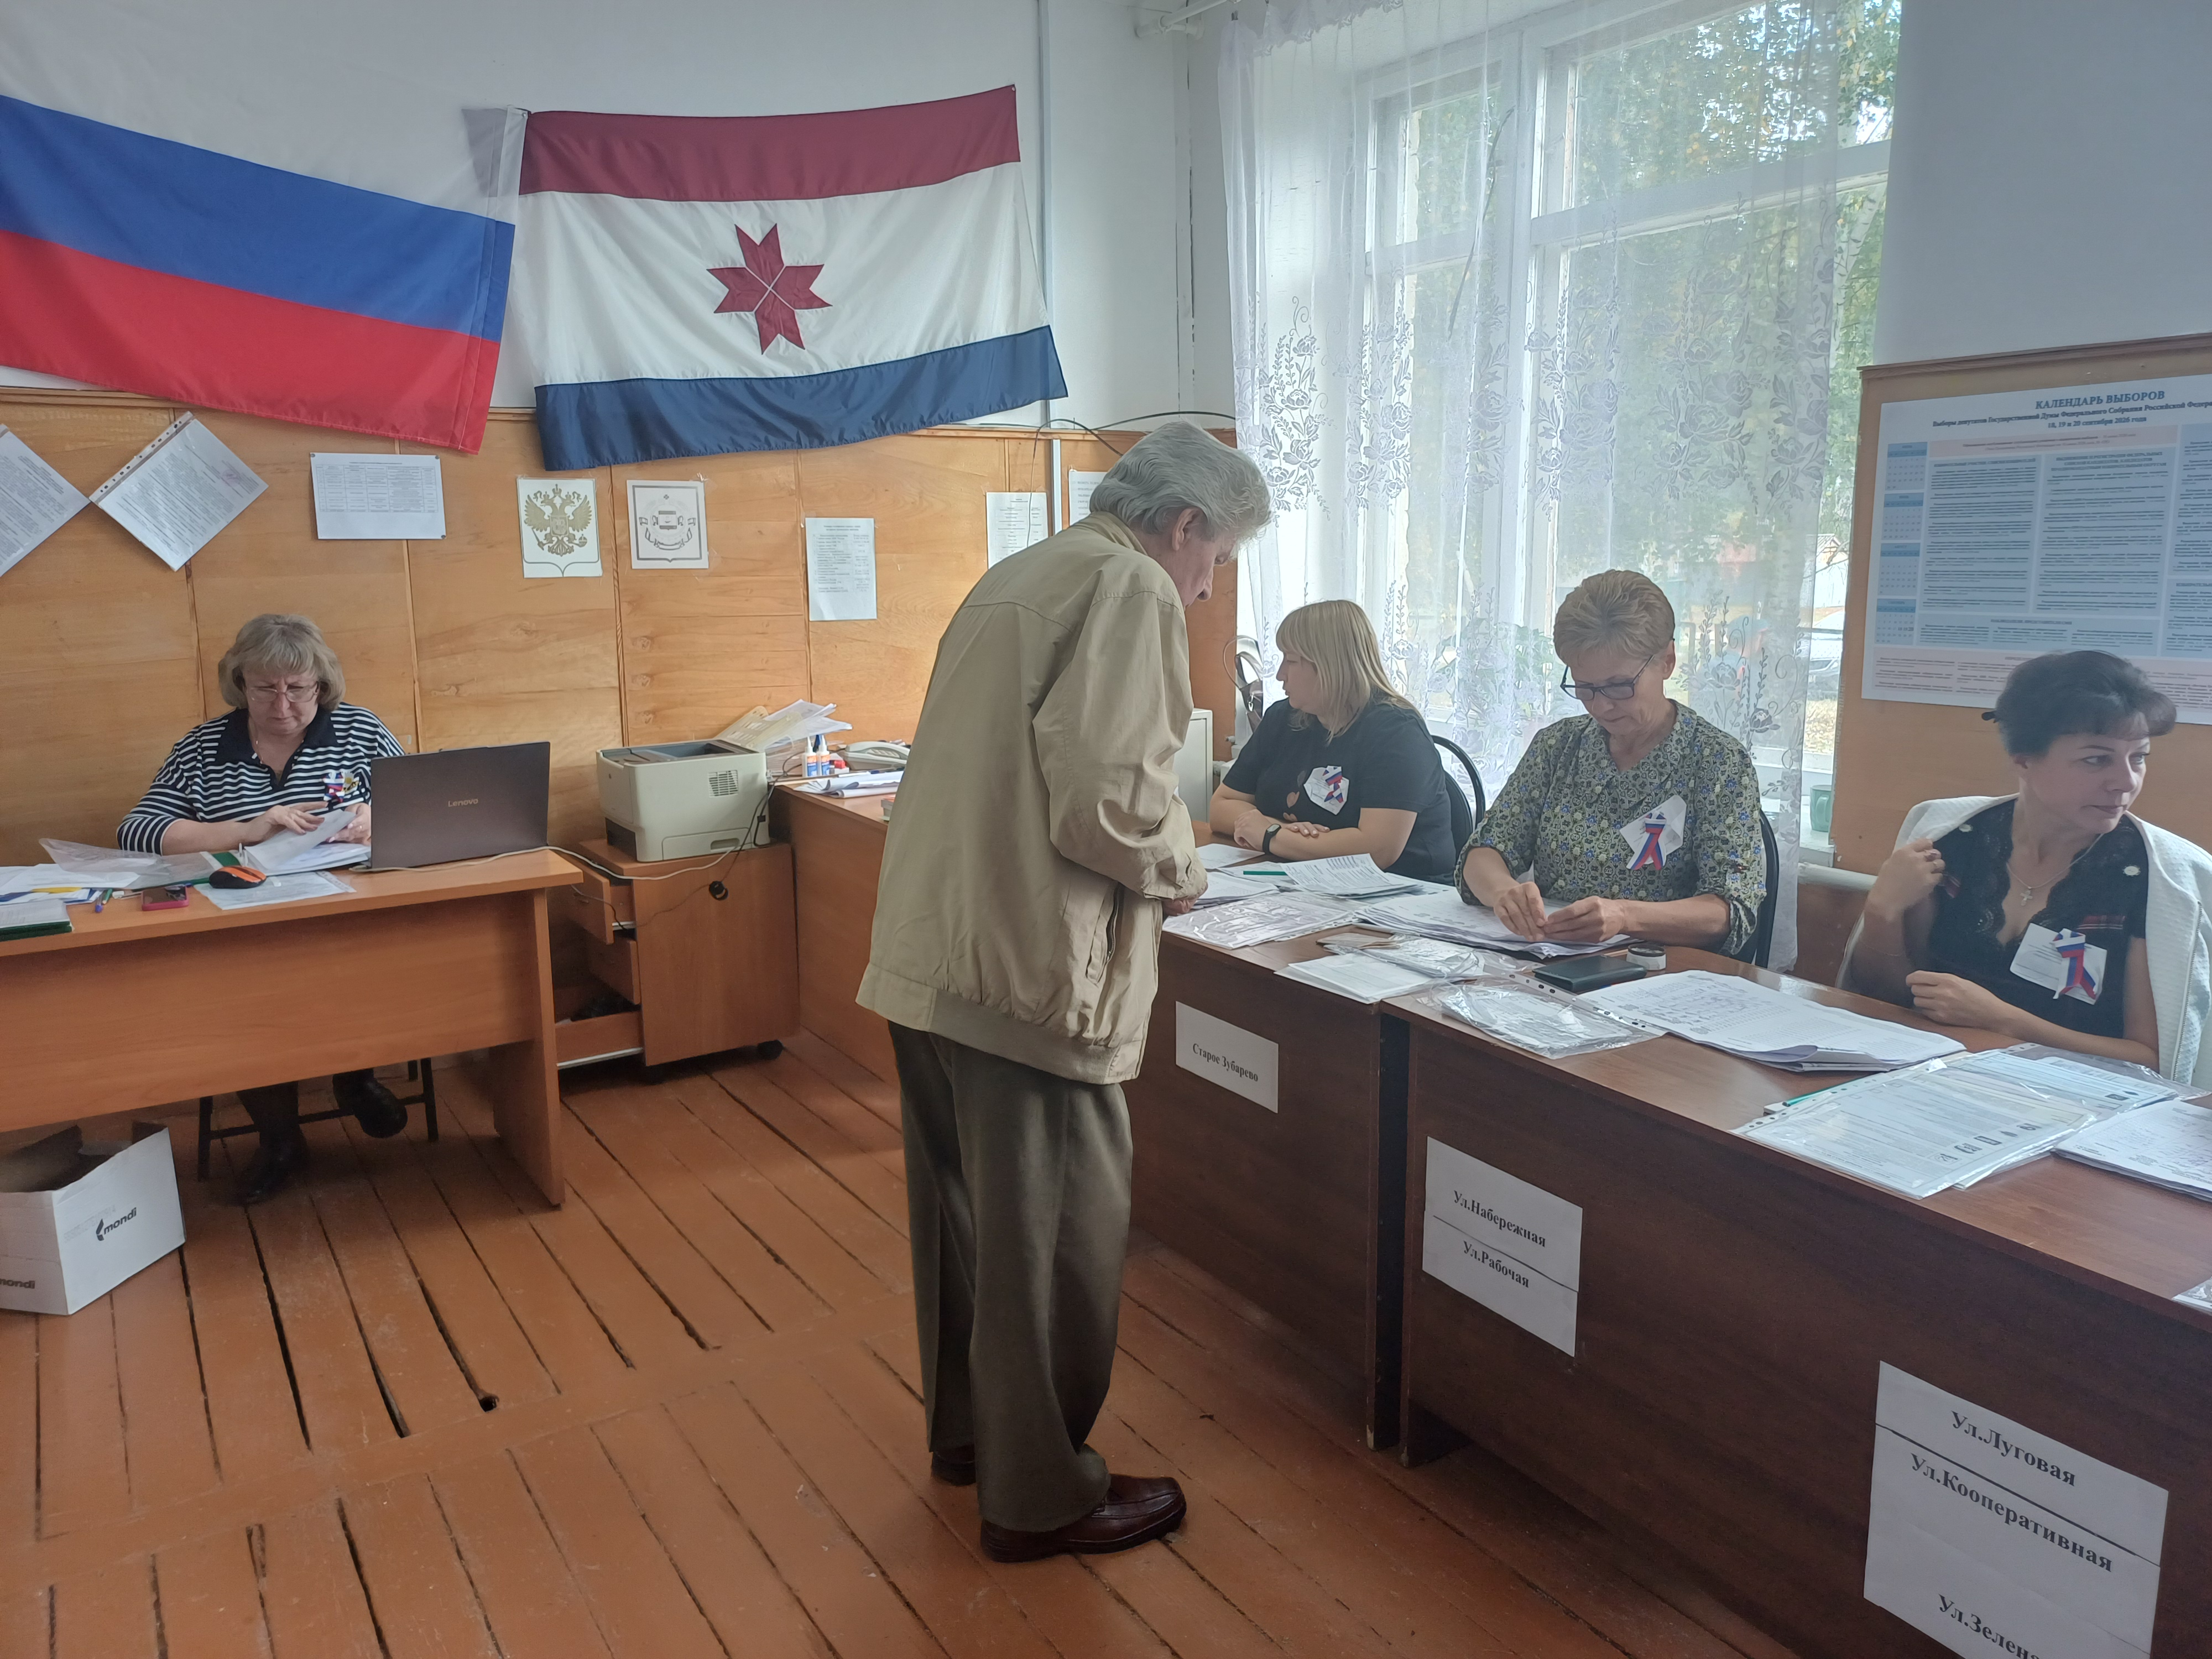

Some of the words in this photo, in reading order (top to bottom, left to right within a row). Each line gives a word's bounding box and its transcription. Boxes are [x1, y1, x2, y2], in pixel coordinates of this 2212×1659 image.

[2035, 396, 2103, 410] КАЛЕНДАРЬ
[2106, 390, 2165, 404] ВЫБОРОВ
[2109, 406, 2143, 415] Собрания
[2144, 402, 2185, 411] Российской
[448, 799, 478, 807] Lenovo
[1193, 1043, 1220, 1065] Старое
[1222, 1056, 1258, 1082] Зубарево
[104, 1207, 137, 1235] mondi
[1453, 1190, 1546, 1248] Ул.Набережная
[1463, 1240, 1529, 1287] Ул.Рабочая
[1951, 1410, 2076, 1486] Ул.Луговая
[1910, 1453, 2112, 1573] Ул.Кооперативная
